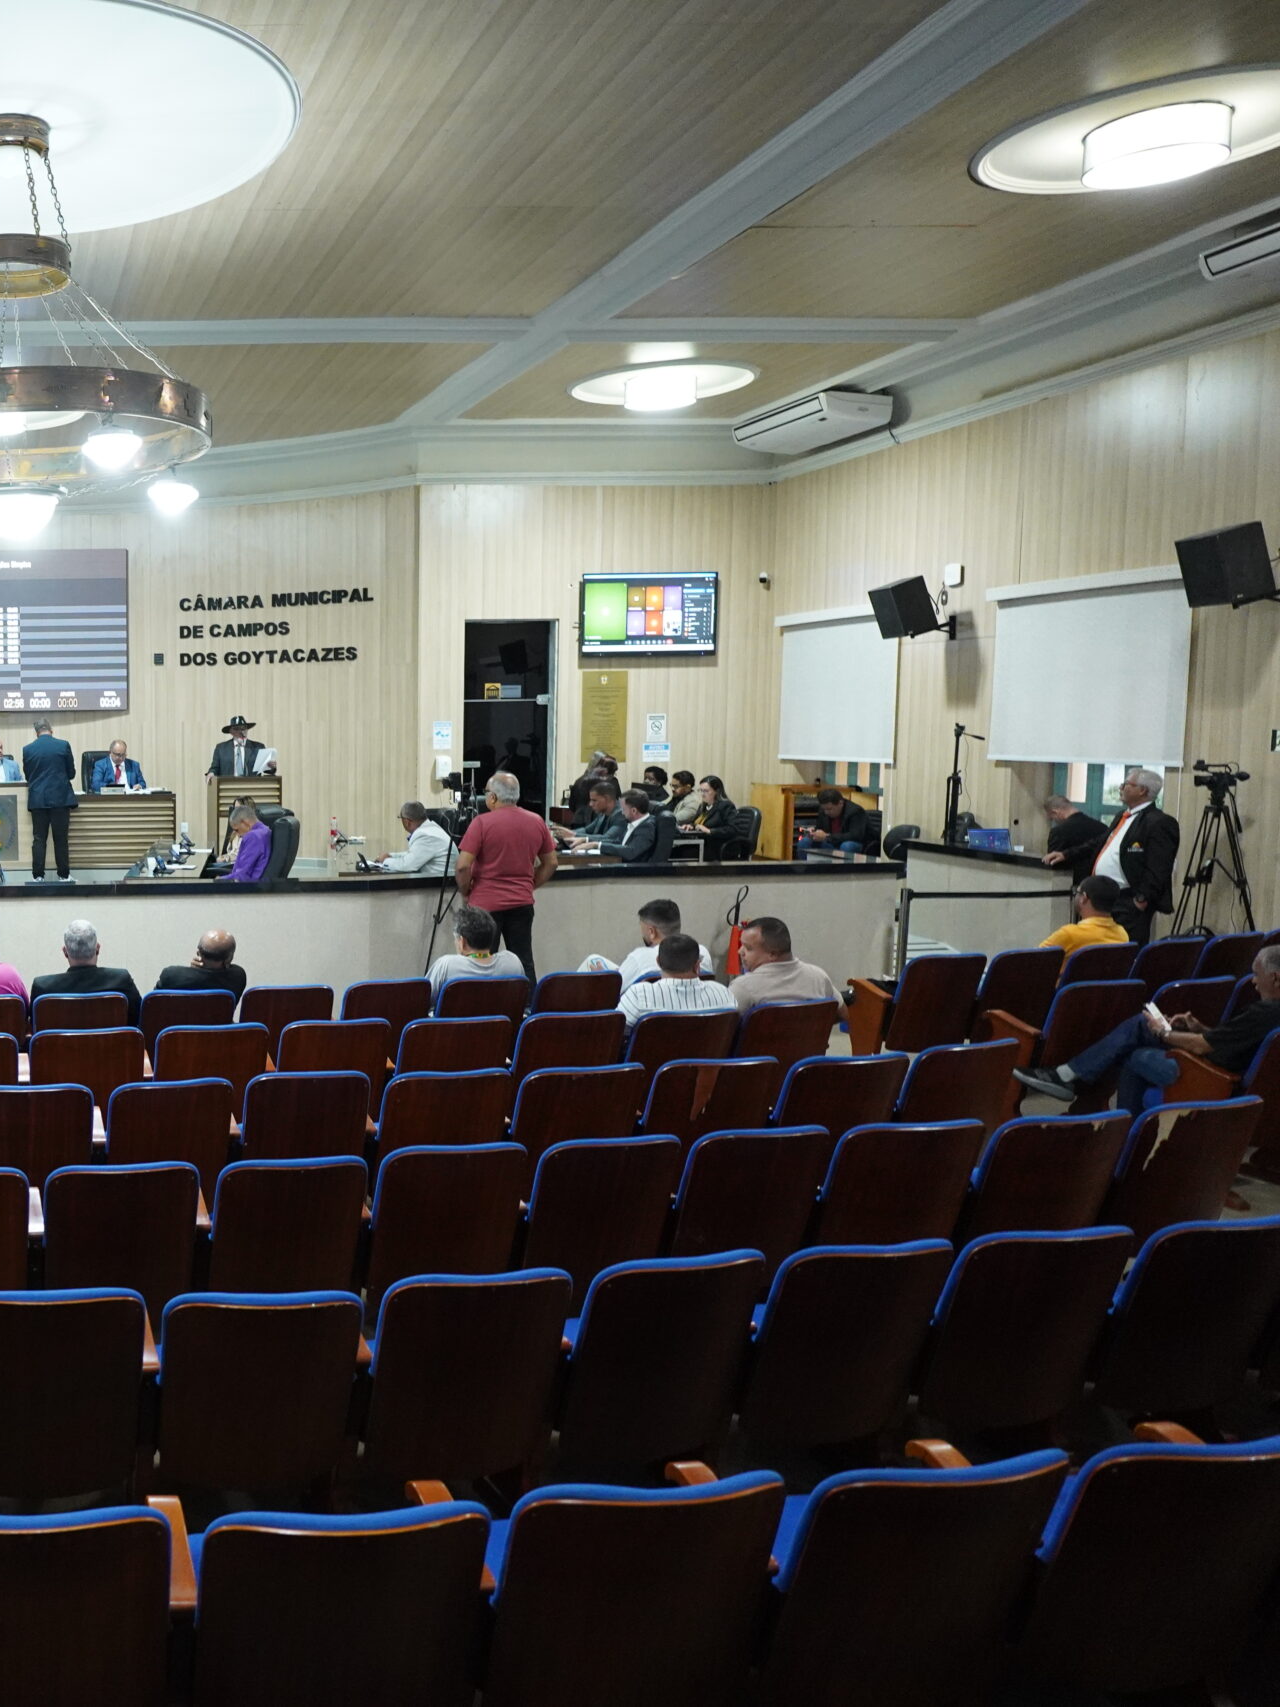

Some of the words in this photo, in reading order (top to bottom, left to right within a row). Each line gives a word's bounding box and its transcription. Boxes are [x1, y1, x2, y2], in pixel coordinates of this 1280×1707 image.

[179, 594, 264, 612] CÂMARA
[271, 588, 374, 607] MUNICIPAL
[179, 625, 204, 639] DE
[209, 621, 290, 638] CAMPOS
[179, 652, 218, 666] DOS
[223, 646, 358, 666] GOYTACAZES
[57, 697, 78, 708] 00:00
